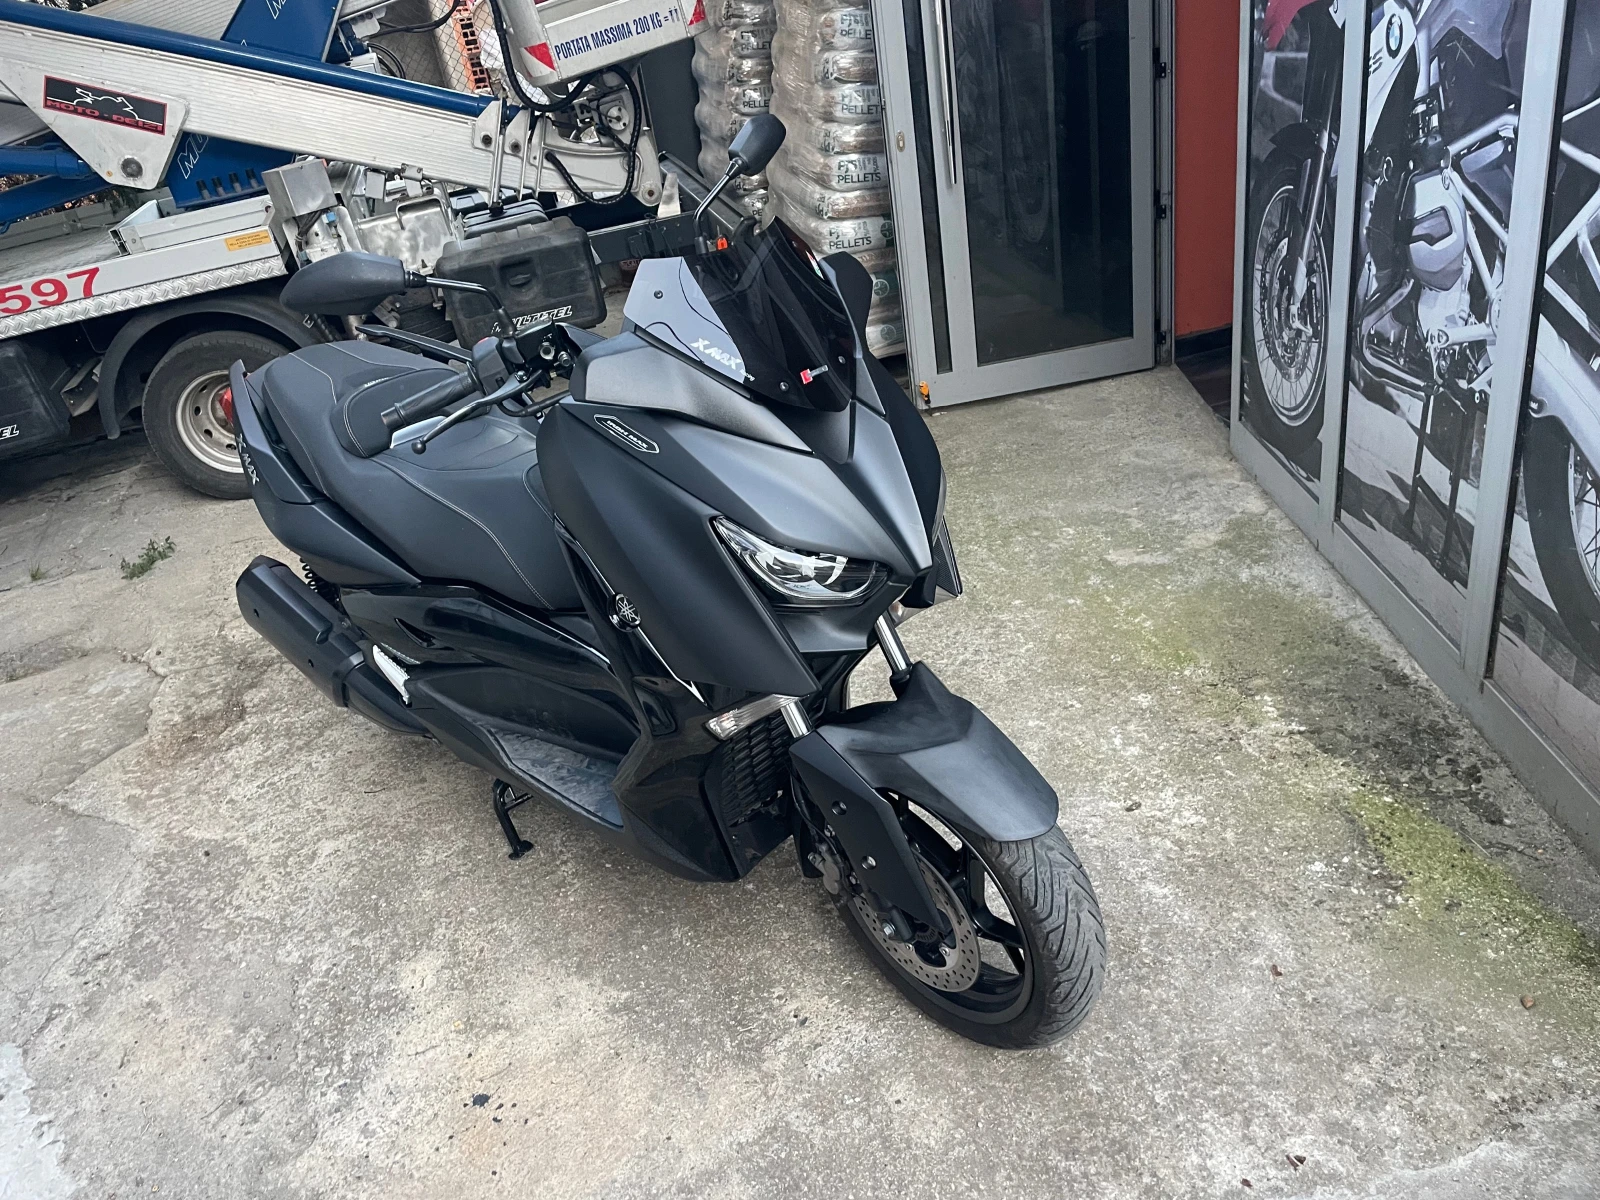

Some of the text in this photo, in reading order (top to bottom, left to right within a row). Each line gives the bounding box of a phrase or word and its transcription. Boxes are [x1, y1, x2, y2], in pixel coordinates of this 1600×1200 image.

[554, 36, 592, 60] PORTATA
[590, 22, 634, 49] MASSIMA
[633, 16, 651, 36] 200
[649, 11, 663, 30] KG
[46, 100, 100, 117] MOTO
[837, 172, 881, 184] PELLETS
[828, 236, 872, 250] PELLETS
[0, 266, 100, 314] 597
